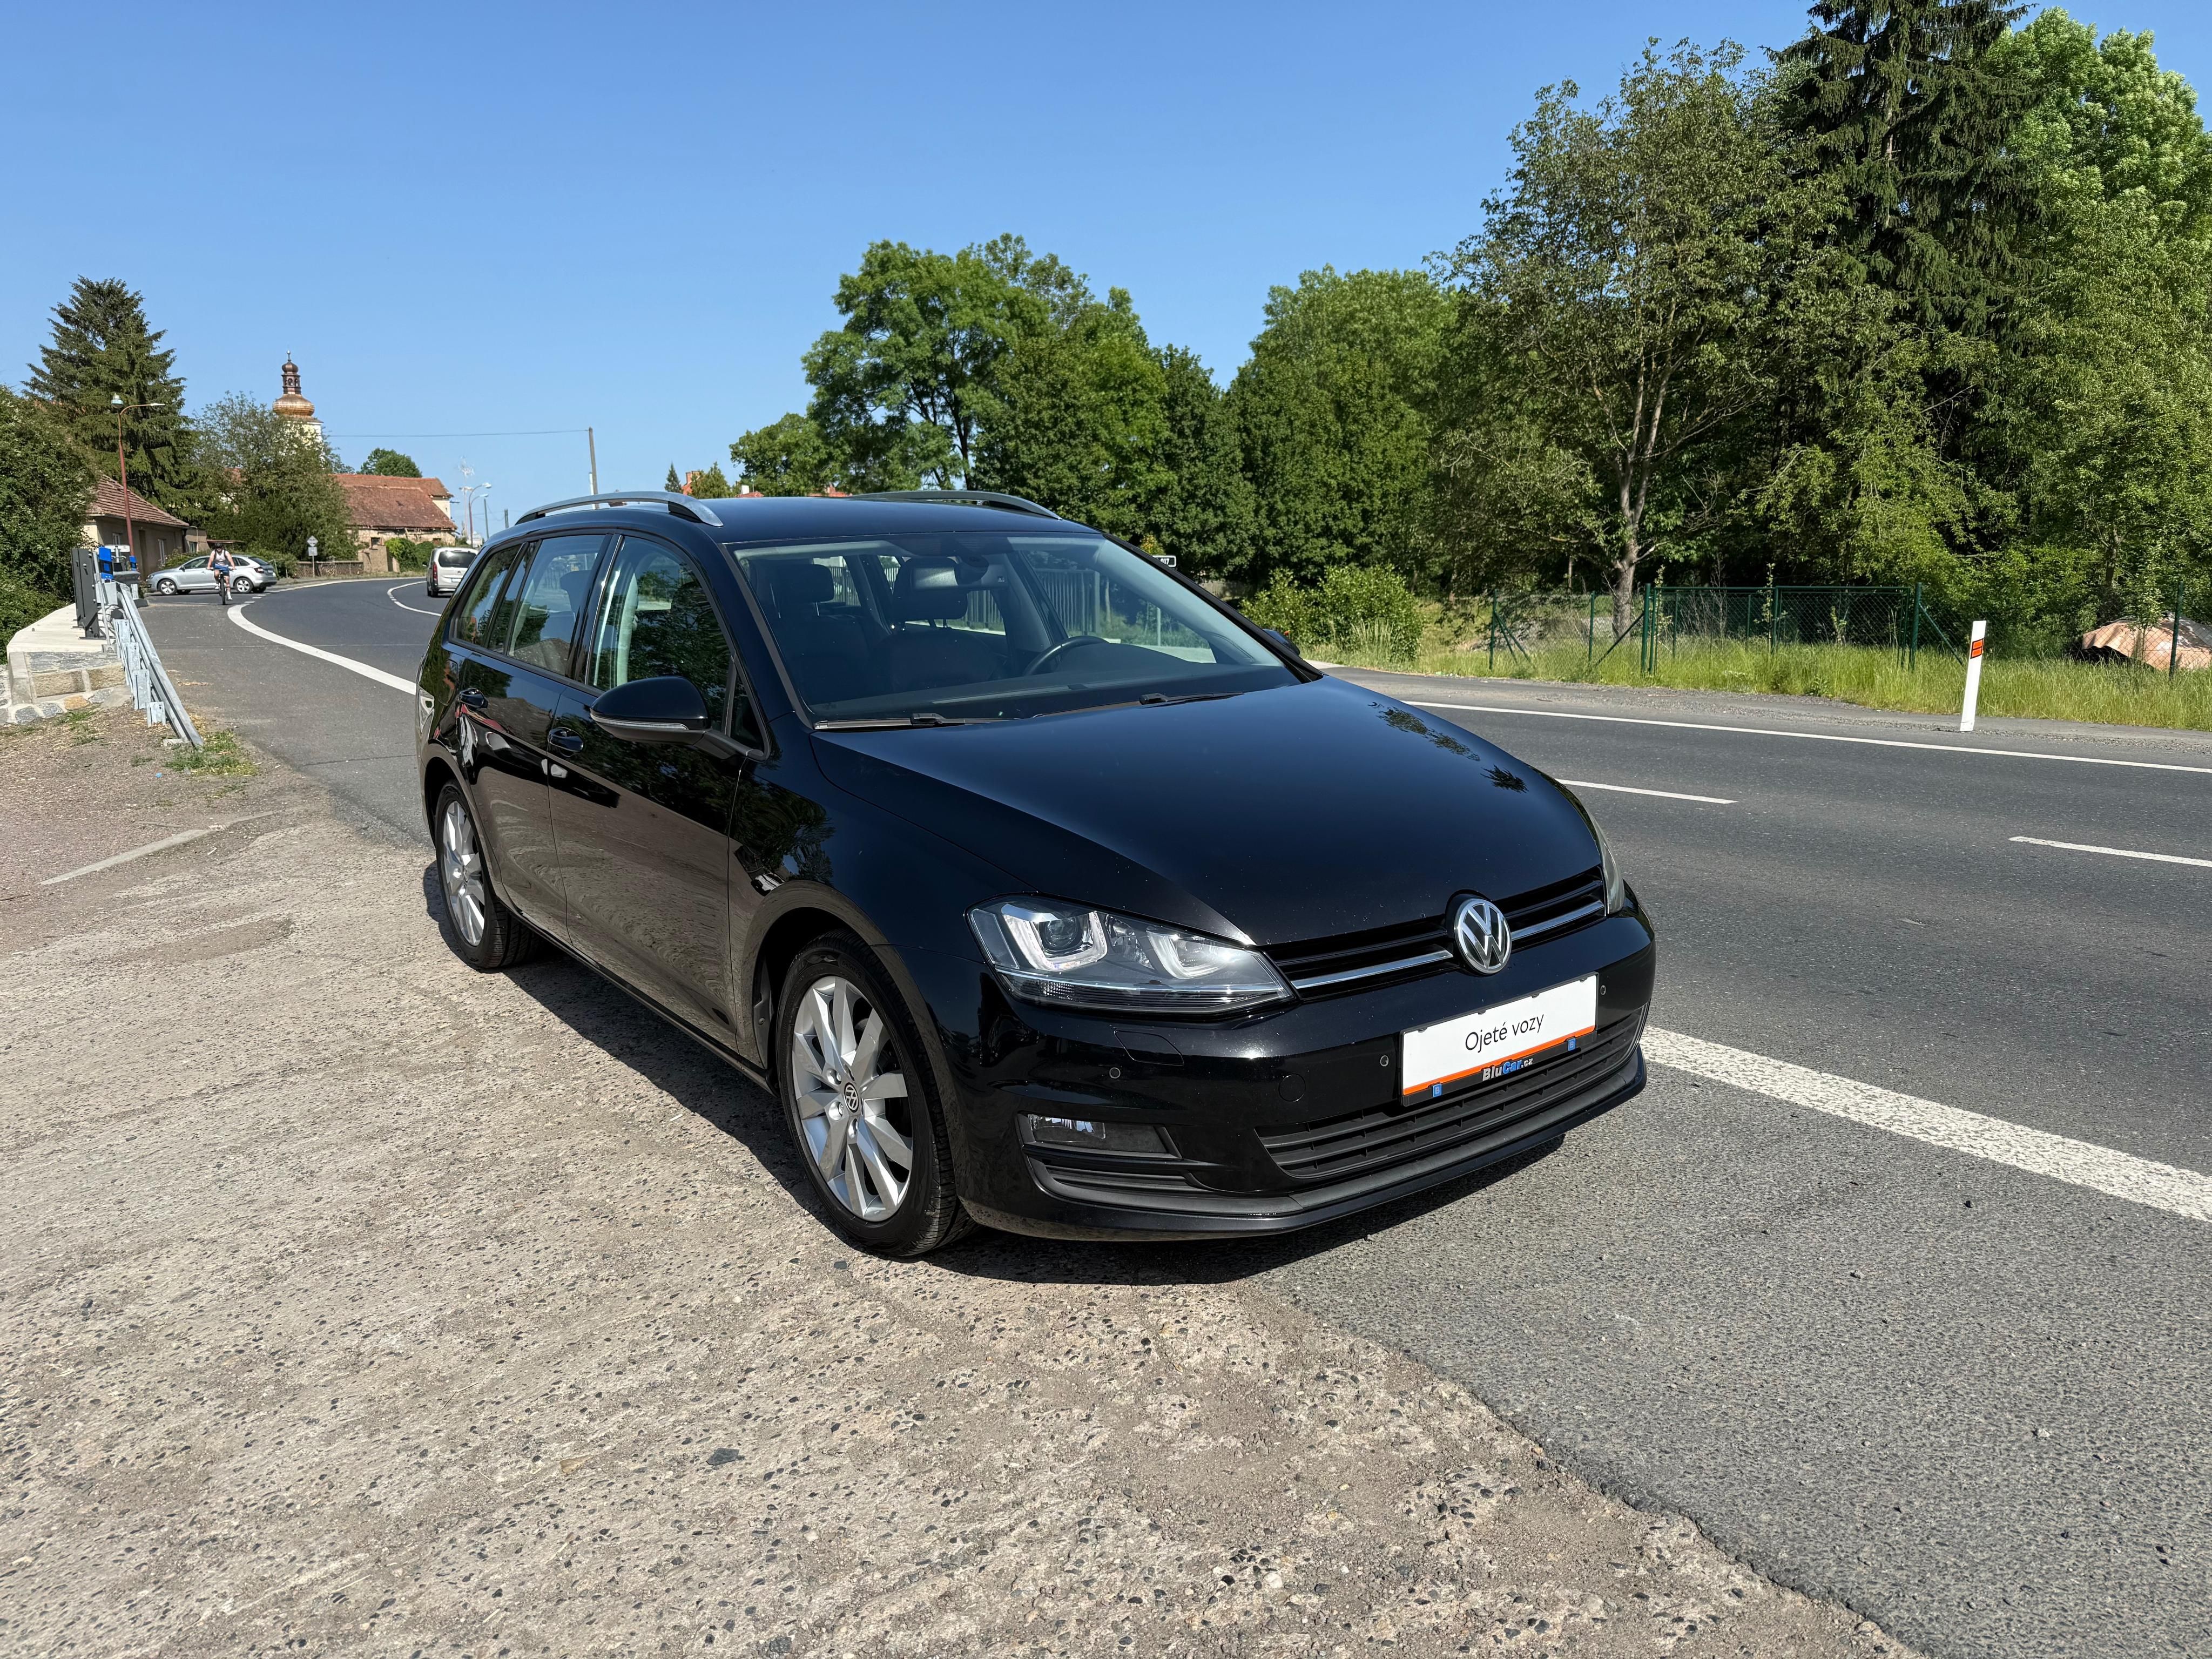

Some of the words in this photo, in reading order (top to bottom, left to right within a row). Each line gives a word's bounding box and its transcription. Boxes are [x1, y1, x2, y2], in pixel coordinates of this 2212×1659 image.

[1457, 900, 1510, 972] VW
[1466, 1022, 1507, 1053] Ojeté
[1512, 1014, 1544, 1036] vozy
[1482, 1058, 1534, 1081] BluCar.cz
